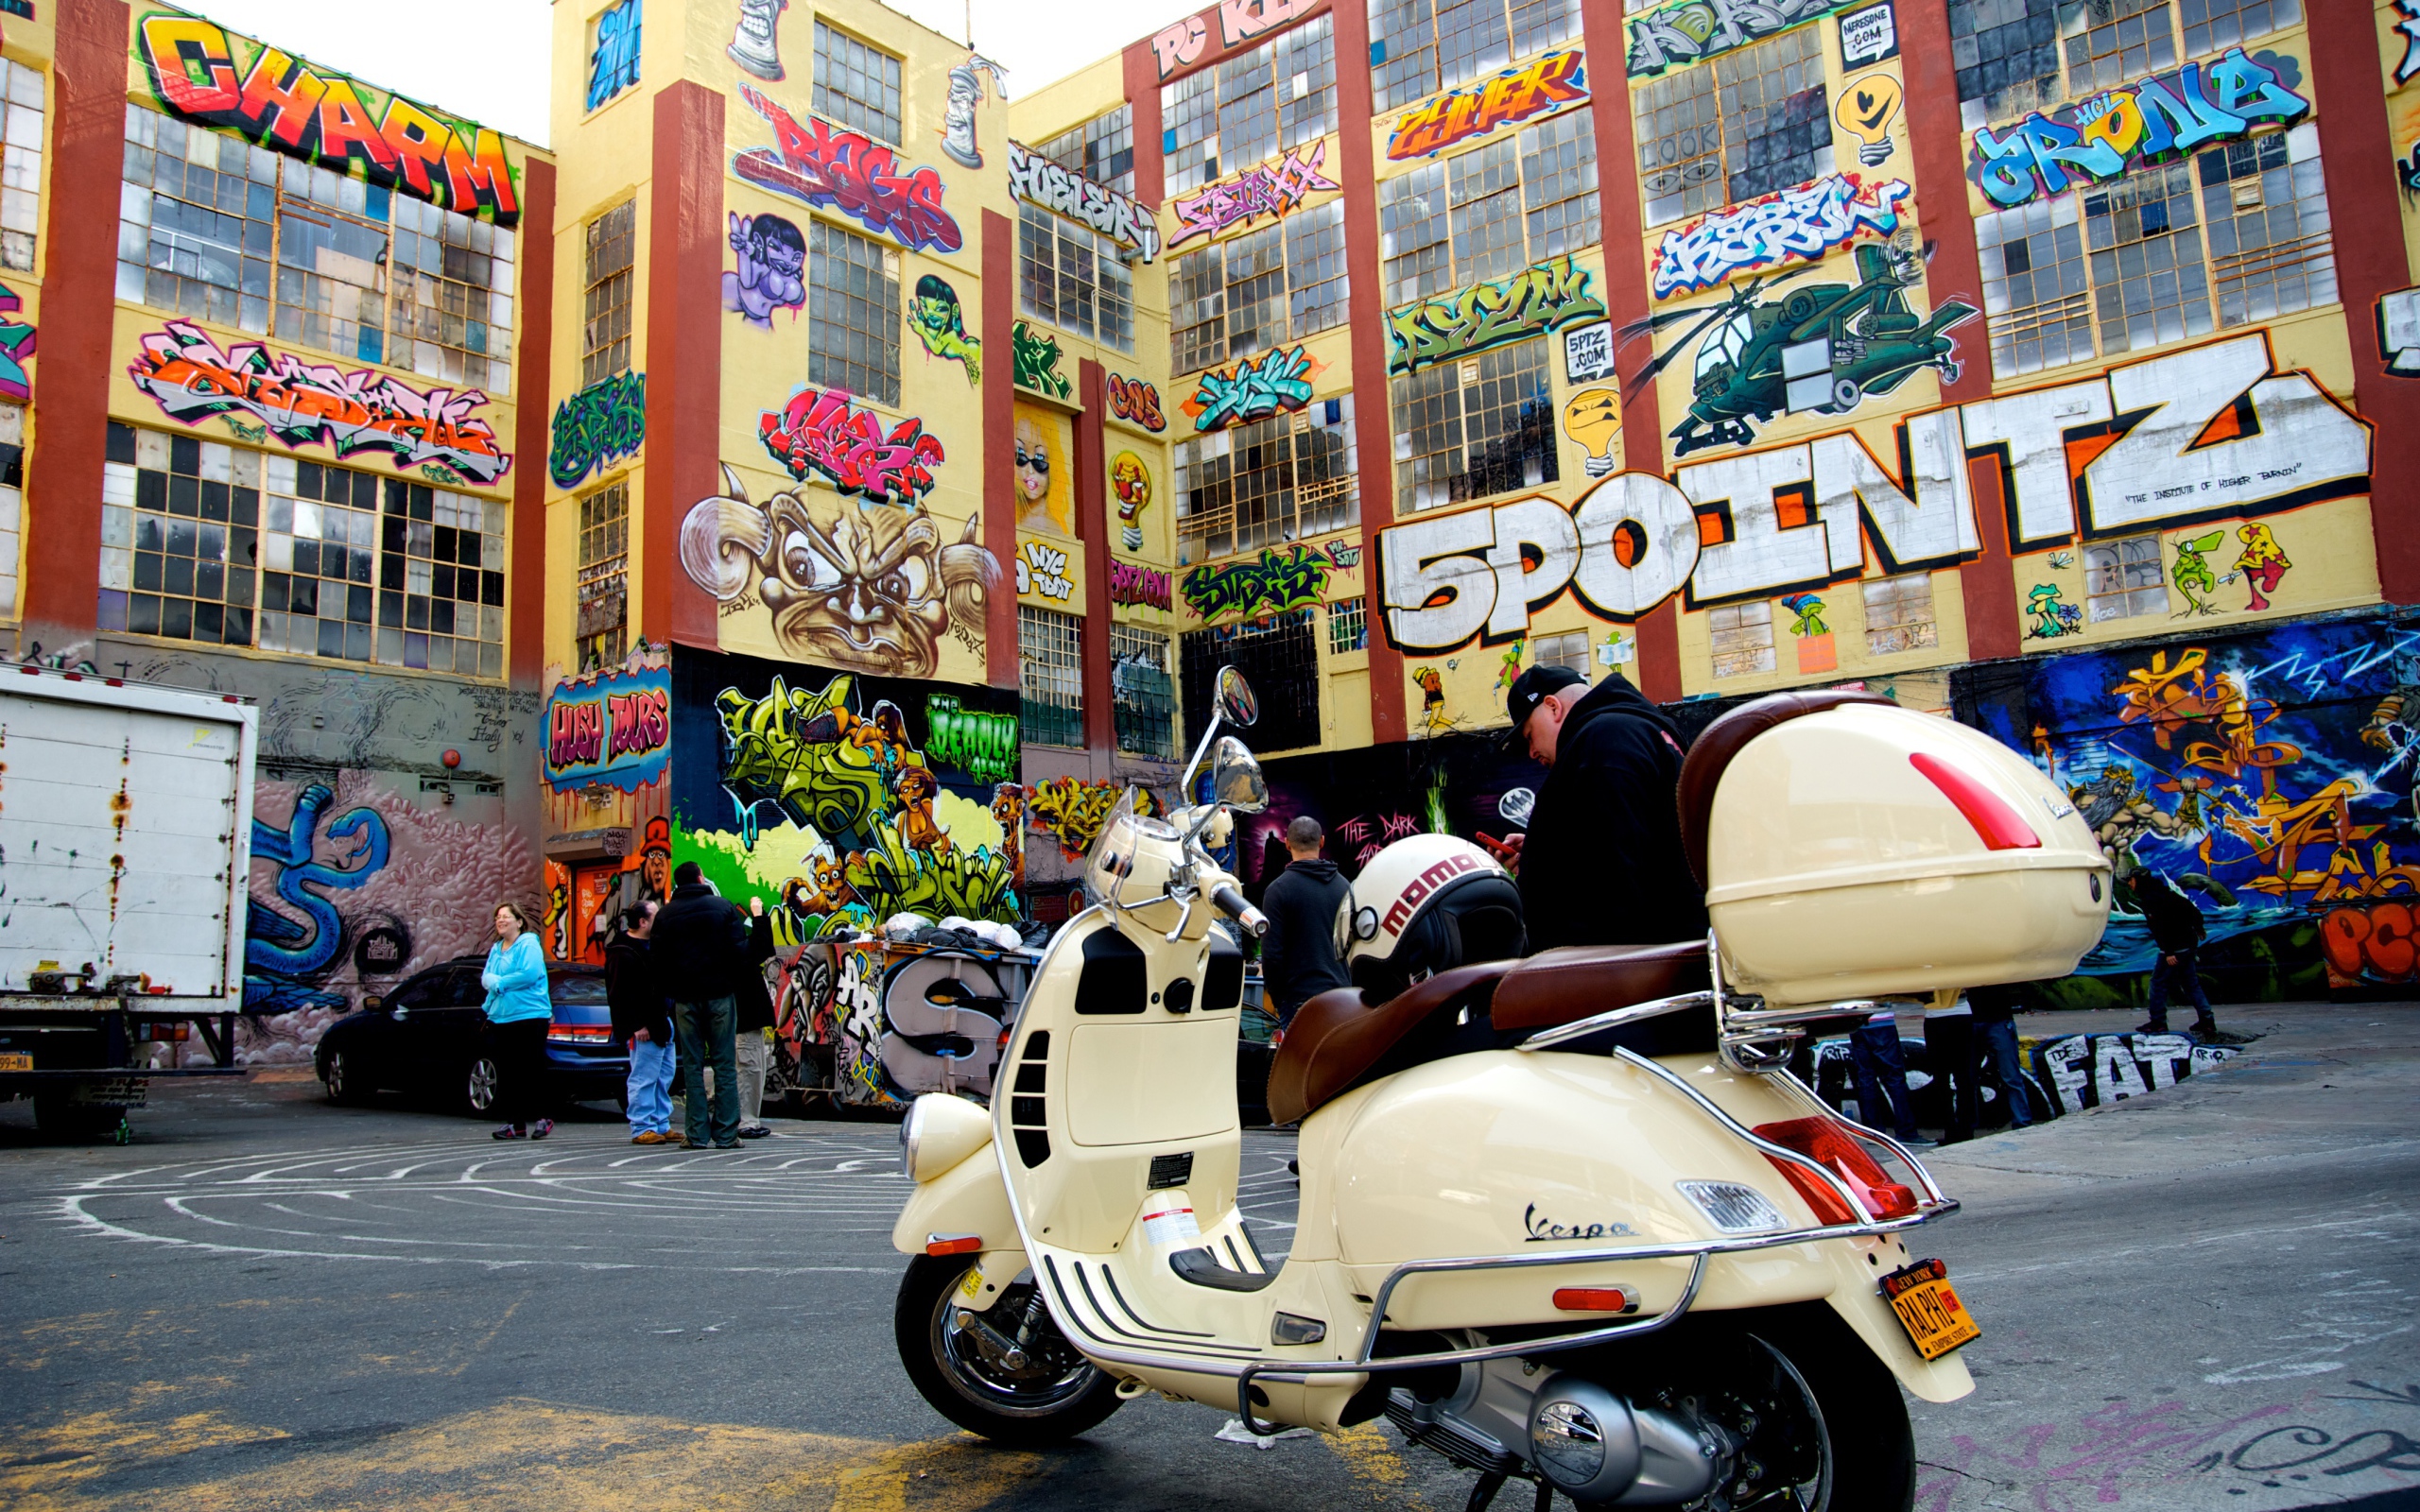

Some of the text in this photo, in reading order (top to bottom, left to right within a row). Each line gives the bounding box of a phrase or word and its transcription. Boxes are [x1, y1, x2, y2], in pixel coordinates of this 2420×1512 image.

[1842, 11, 1888, 35] MERESONE
[140, 15, 519, 228] CHARM
[1642, 124, 1718, 170] LOOK
[1569, 329, 1606, 352] 5PTZ
[1575, 346, 1607, 369] .COM
[1379, 333, 2373, 652] 5POINTZ
[2201, 481, 2212, 490] OF
[2218, 475, 2251, 489] HIGHER
[1026, 541, 1067, 576] NYC
[550, 702, 603, 771] HUSH
[608, 690, 668, 764] TOURS
[929, 710, 1016, 764] DEADLY
[1334, 812, 1422, 846] THE DARK
[390, 851, 462, 886] MACH
[2043, 1032, 2194, 1115] FAT
[1525, 1201, 1641, 1242] Vespa
[1930, 1325, 1970, 1352] EMPIRE STATE
